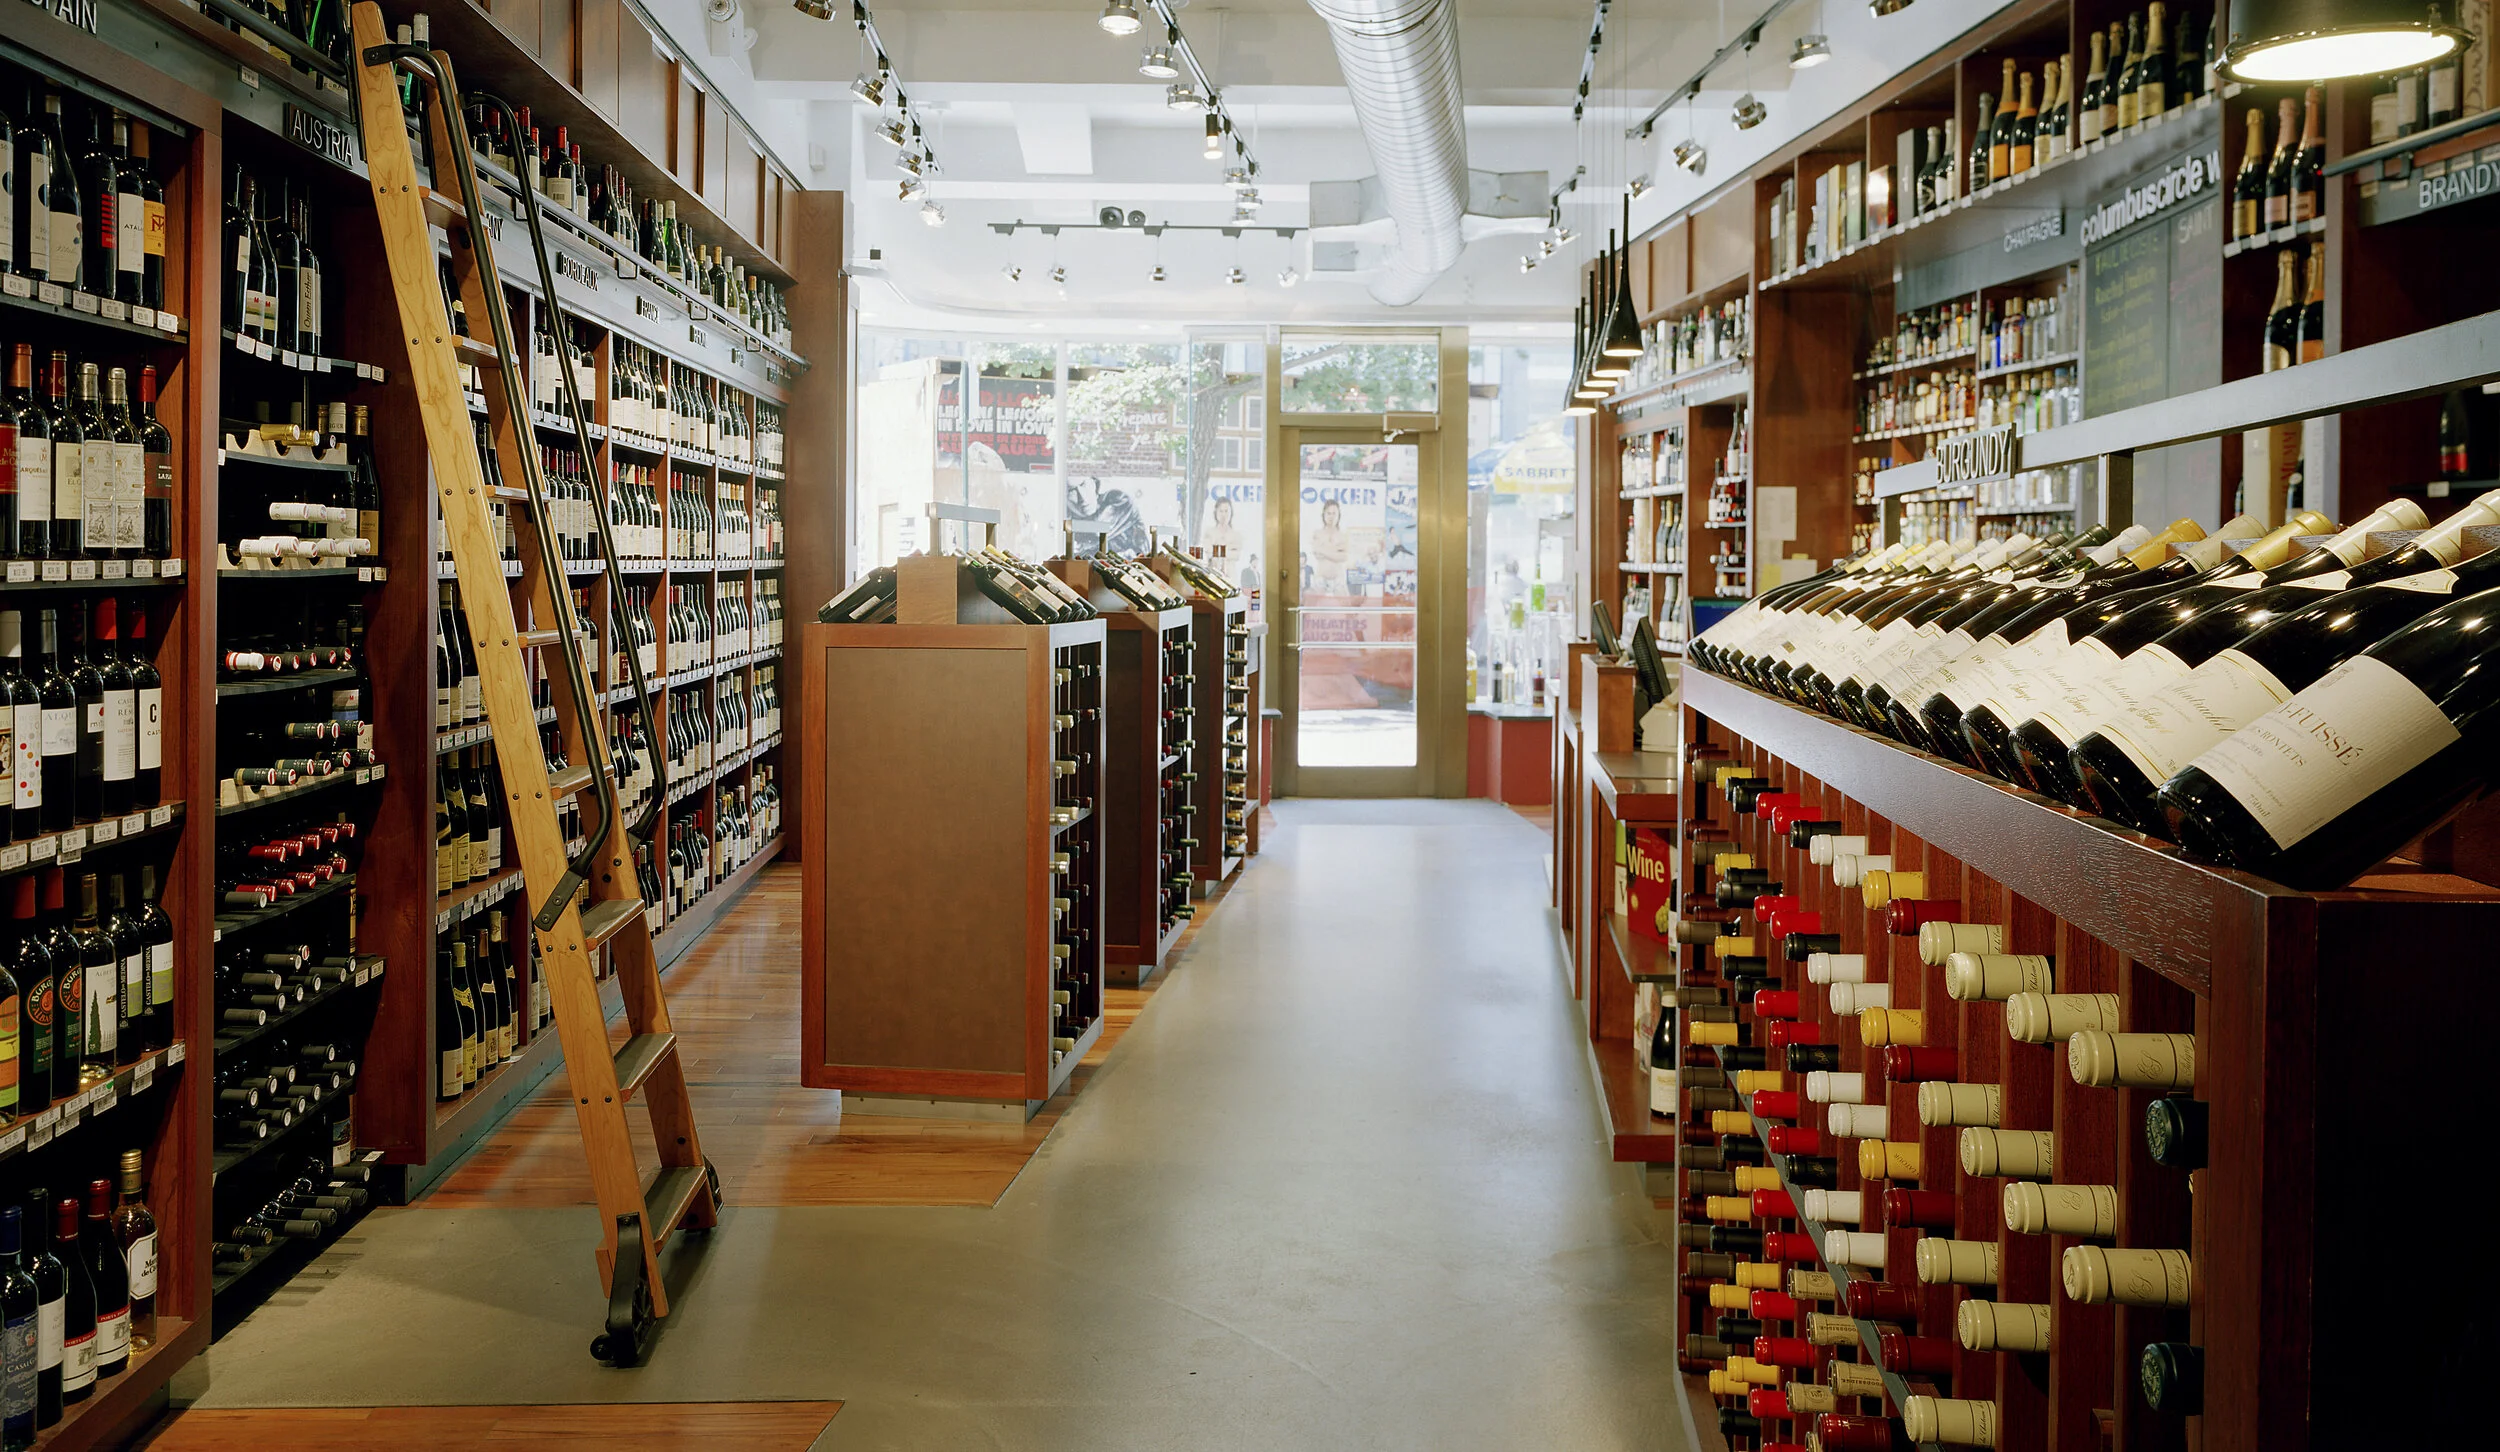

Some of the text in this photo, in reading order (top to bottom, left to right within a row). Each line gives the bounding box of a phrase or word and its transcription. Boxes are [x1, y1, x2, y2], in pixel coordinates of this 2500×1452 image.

[31, 0, 97, 34] AIN
[293, 109, 354, 166] AUSTRIA
[561, 252, 599, 291] BORDEAUX
[997, 420, 1012, 433] IN
[1505, 466, 1576, 478] SABRET
[1937, 428, 2011, 484] BURGUNDY
[1627, 843, 1665, 883] Wine
